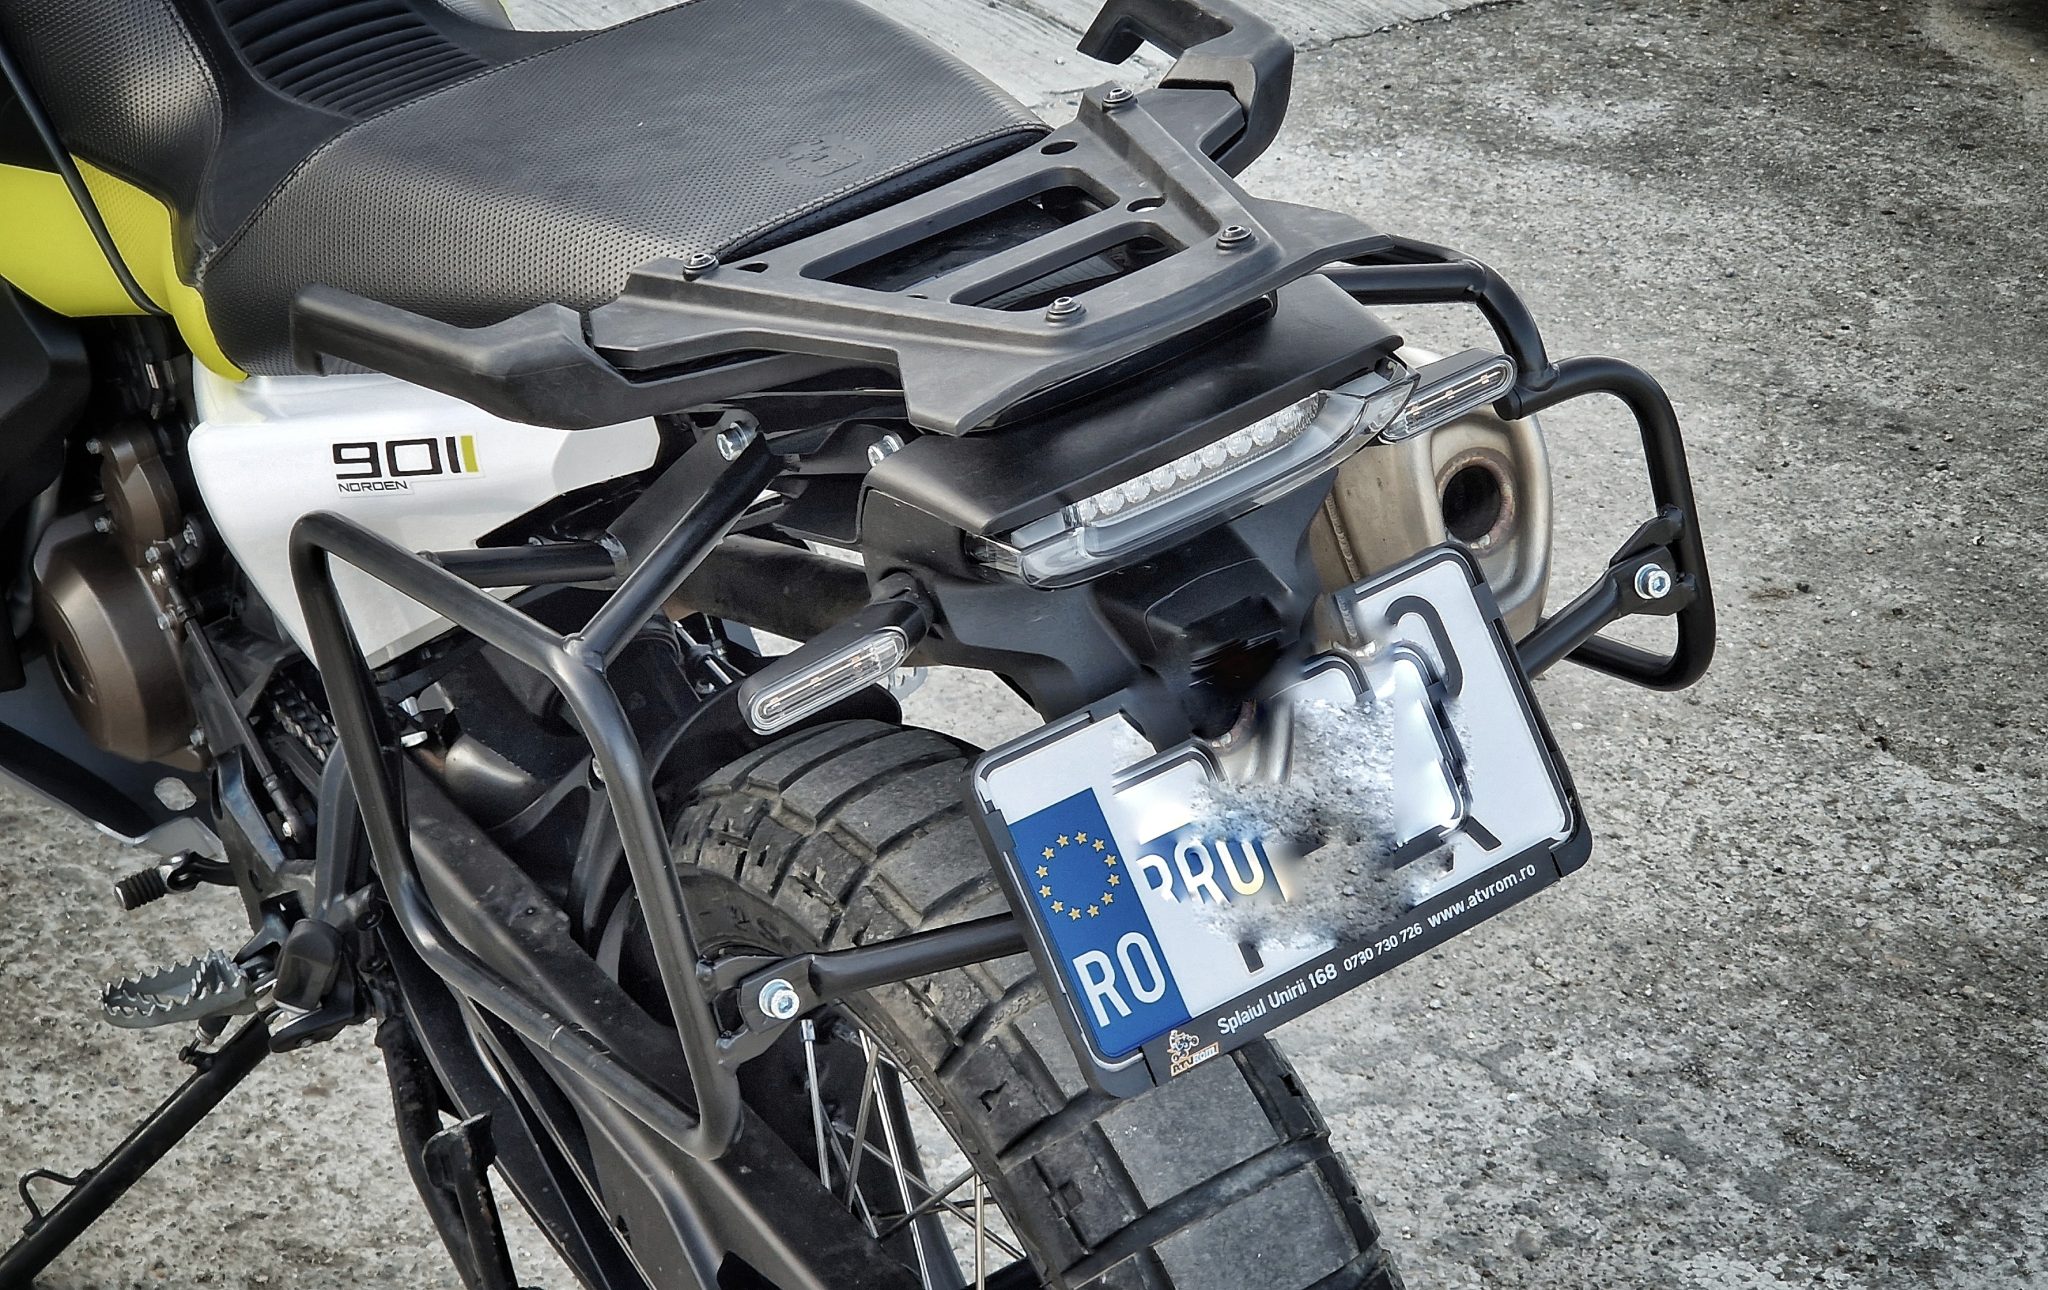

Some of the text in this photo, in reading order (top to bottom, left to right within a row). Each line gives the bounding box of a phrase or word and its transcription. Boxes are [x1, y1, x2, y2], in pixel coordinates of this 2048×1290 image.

[337, 480, 408, 493] NORDEN
[1072, 931, 1166, 1028] RO
[1217, 863, 1536, 1035] Splaiul Unirii 168 0730 730 726 www.atvrom.ro
